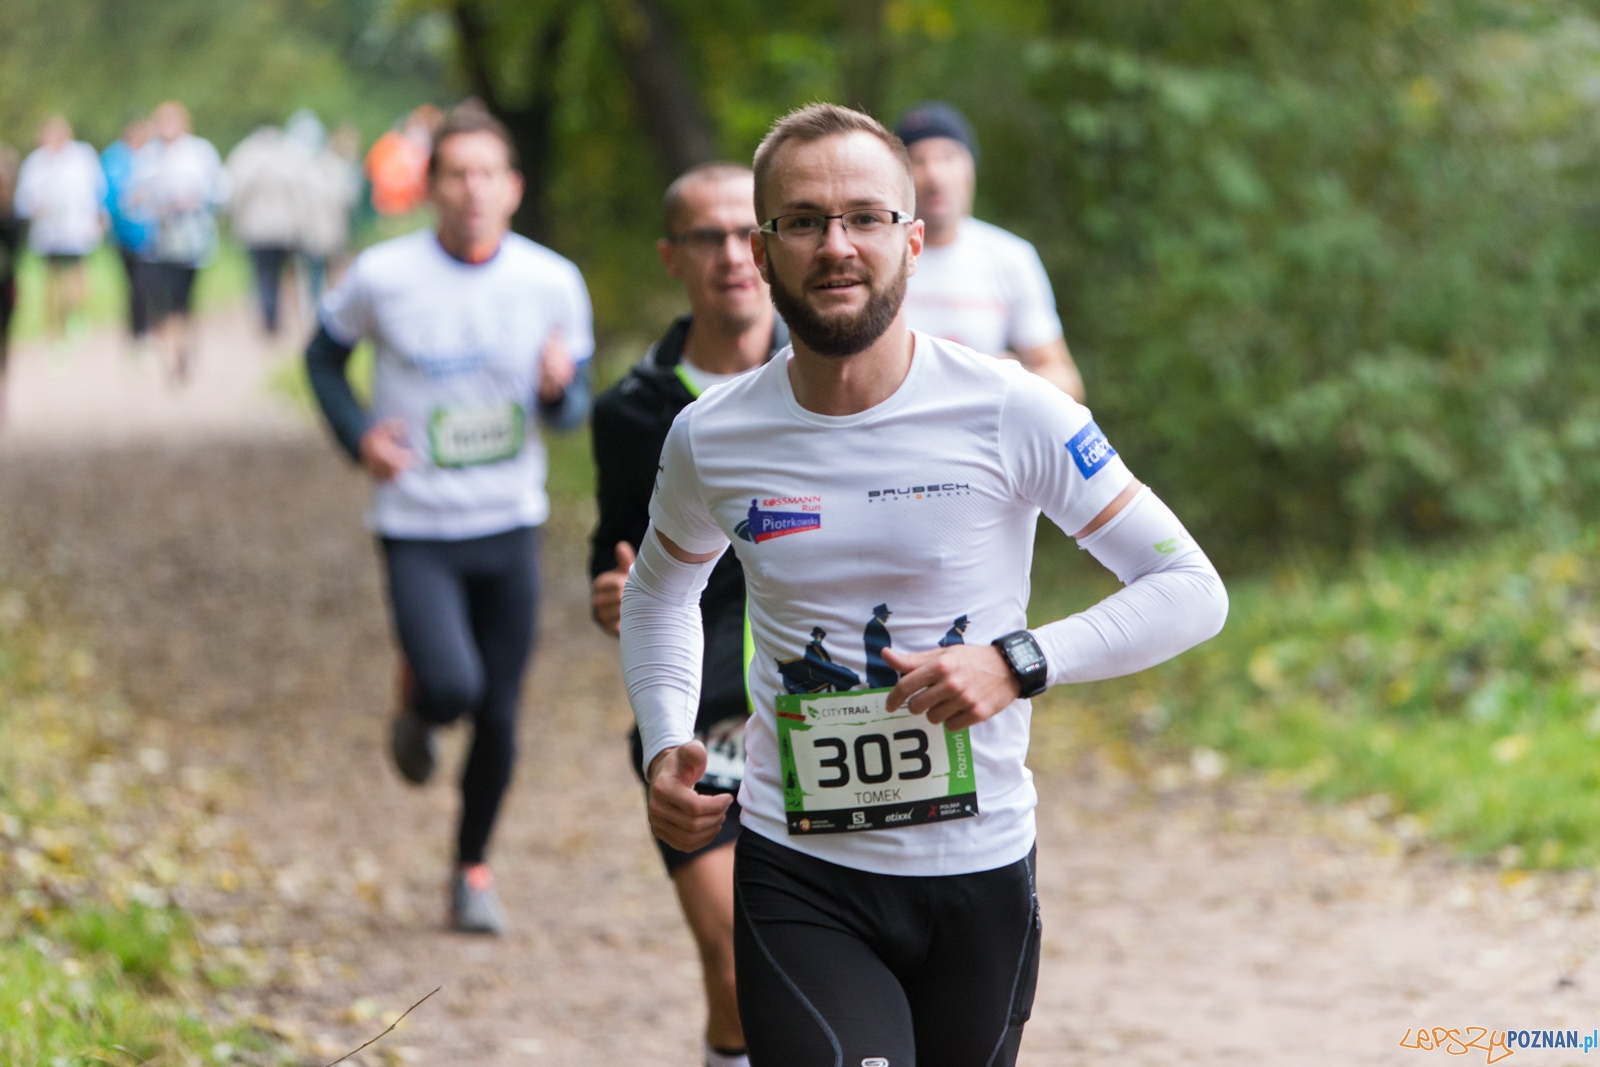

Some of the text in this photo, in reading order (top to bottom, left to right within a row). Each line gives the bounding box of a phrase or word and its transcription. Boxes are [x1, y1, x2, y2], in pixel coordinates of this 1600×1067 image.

[802, 504, 821, 512] Run
[813, 729, 932, 788] 303
[854, 789, 902, 804] TOMEK
